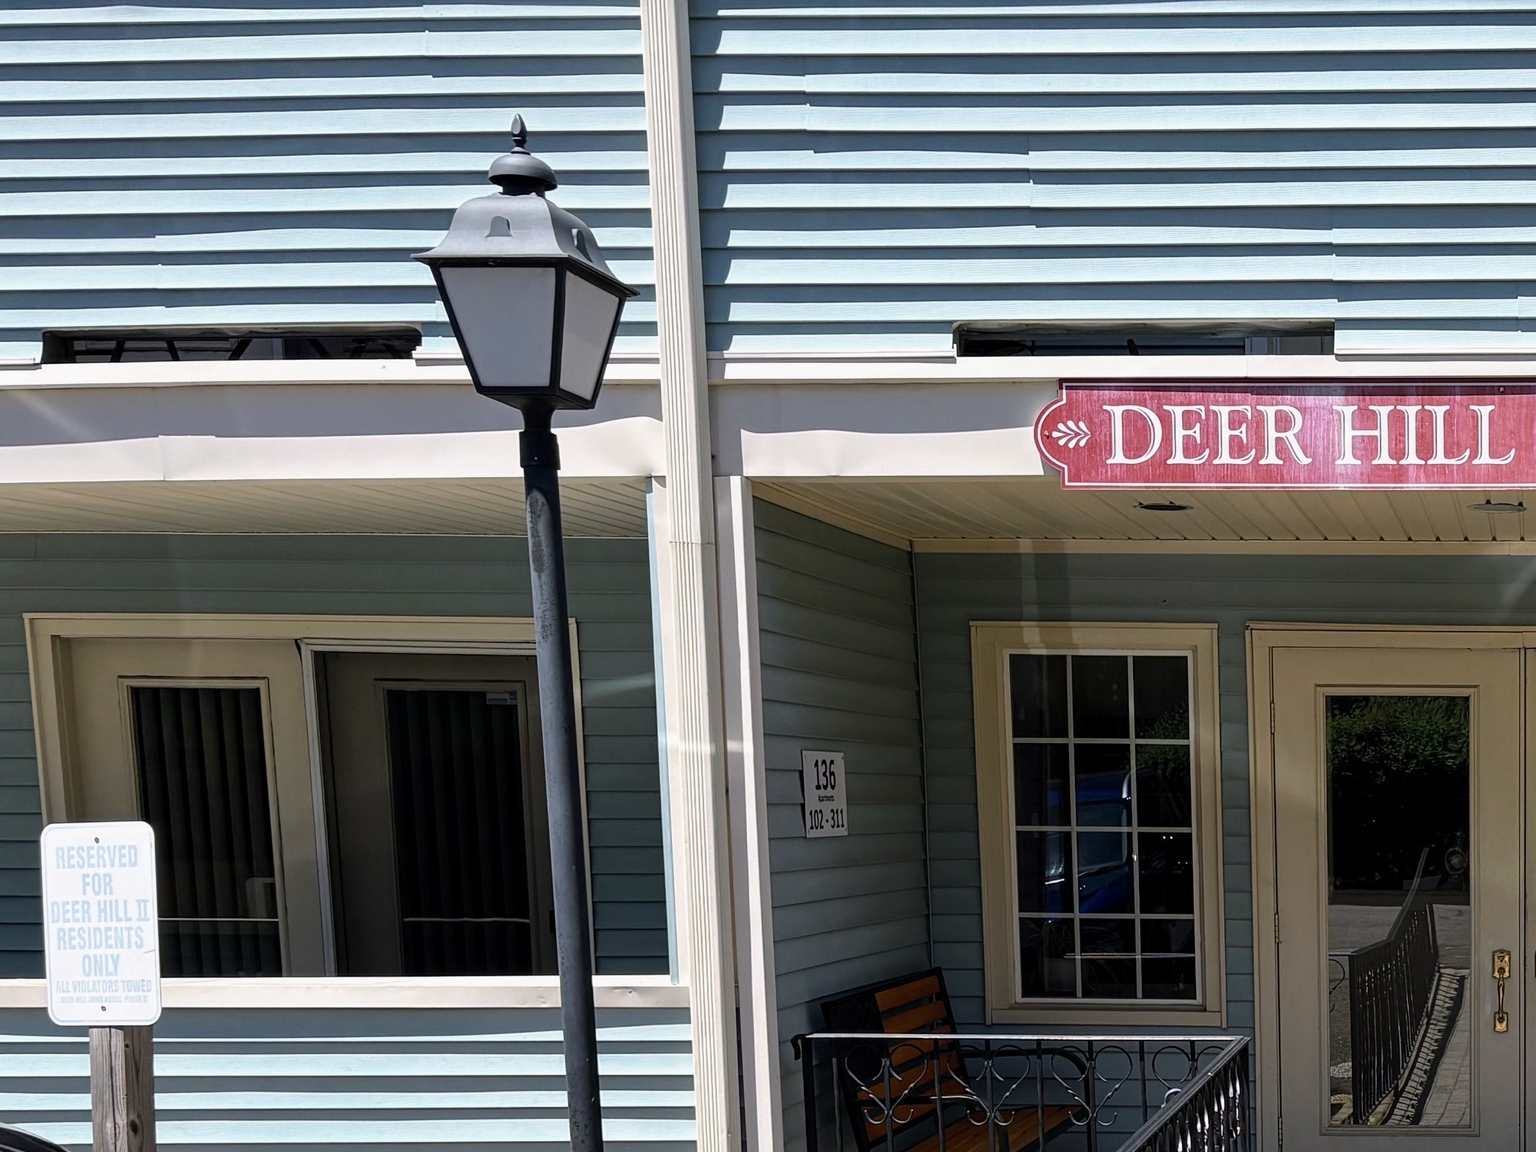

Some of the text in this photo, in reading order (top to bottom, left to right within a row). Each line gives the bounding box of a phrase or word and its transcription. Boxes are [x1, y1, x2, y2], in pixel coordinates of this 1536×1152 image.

[1102, 404, 1313, 466] DEER
[1335, 404, 1515, 466] HILL
[814, 759, 836, 790] 136
[55, 844, 138, 870] RESERVED
[82, 872, 114, 896] FOR
[51, 899, 150, 923] DEER HILL II
[57, 926, 144, 950] RESIDENTS
[81, 953, 120, 977] ONLY
[56, 979, 152, 993] ALL VIOLATORS TOWED
